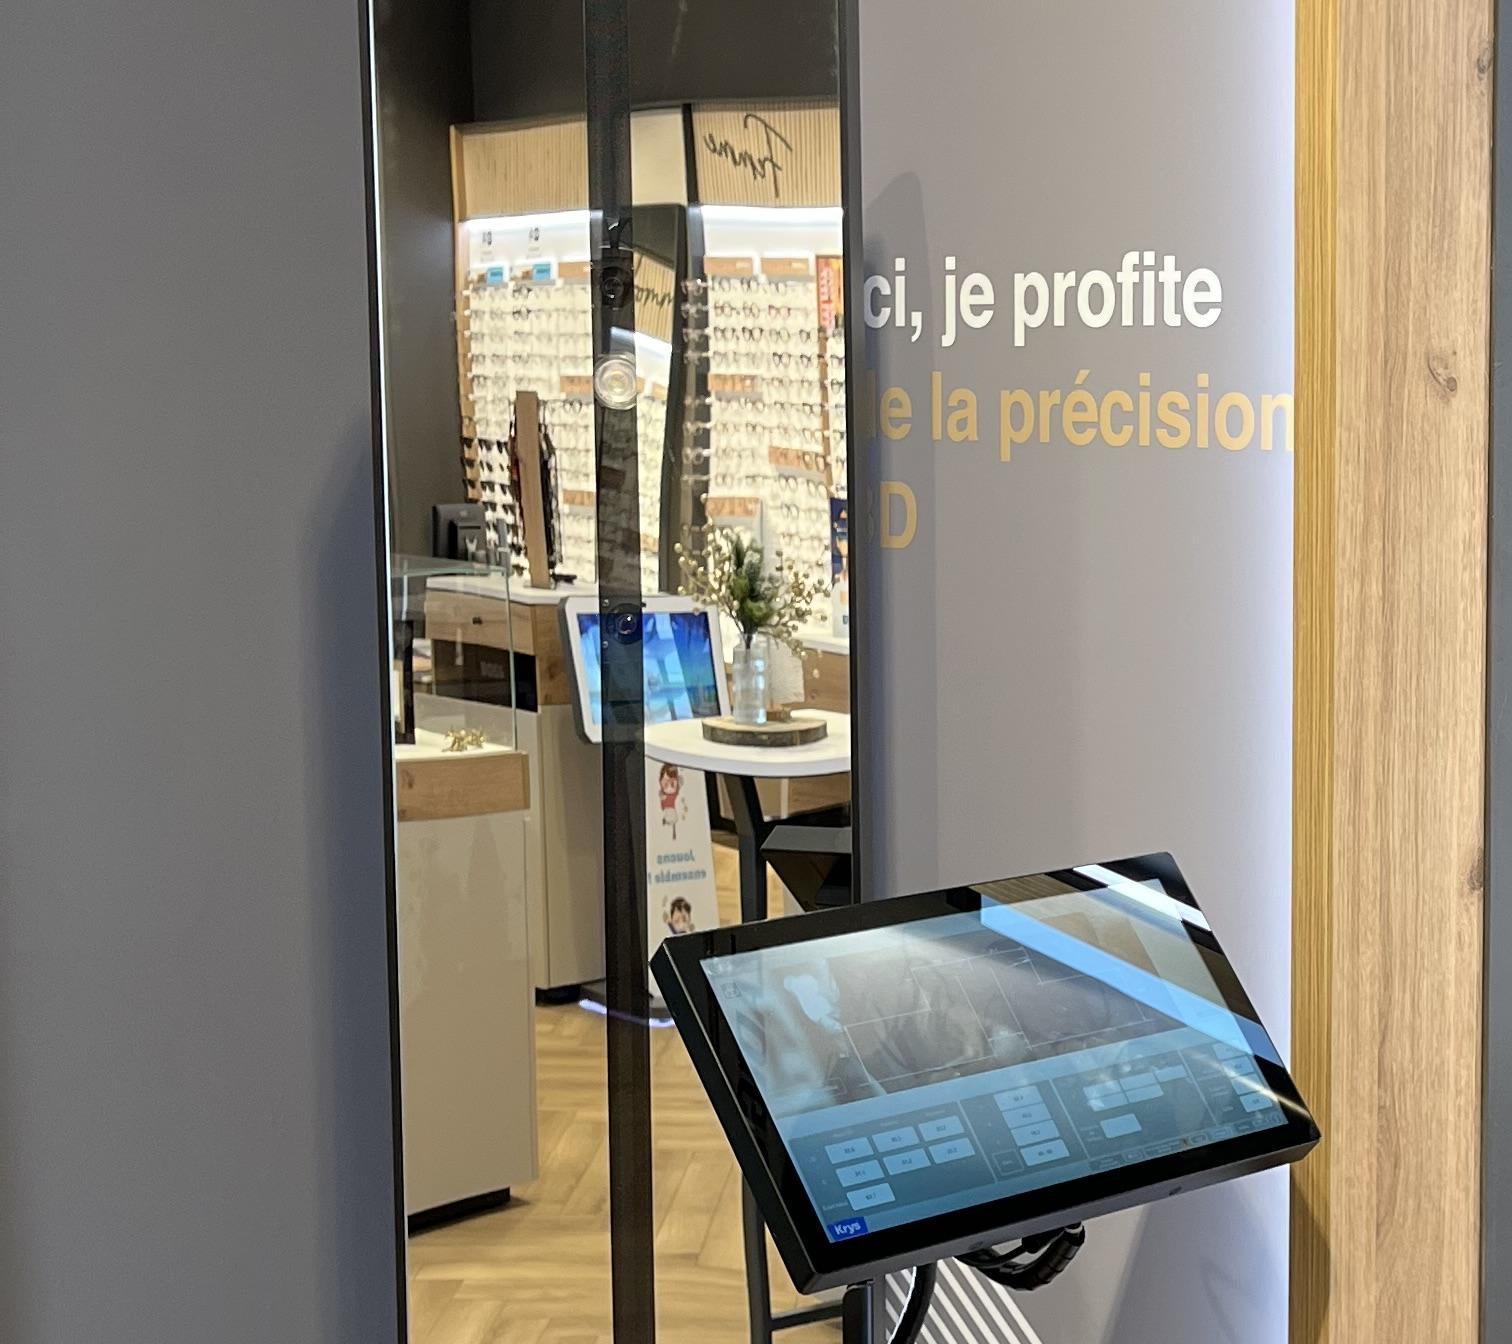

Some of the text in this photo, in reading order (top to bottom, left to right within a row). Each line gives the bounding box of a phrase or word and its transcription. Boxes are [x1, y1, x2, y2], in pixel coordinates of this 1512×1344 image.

[863, 256, 923, 343] ci,
[941, 256, 996, 347] je
[1014, 250, 1223, 347] profite
[931, 371, 979, 443] la
[1000, 369, 1294, 462] précision
[866, 480, 918, 550] D
[833, 1222, 861, 1236] Krys
